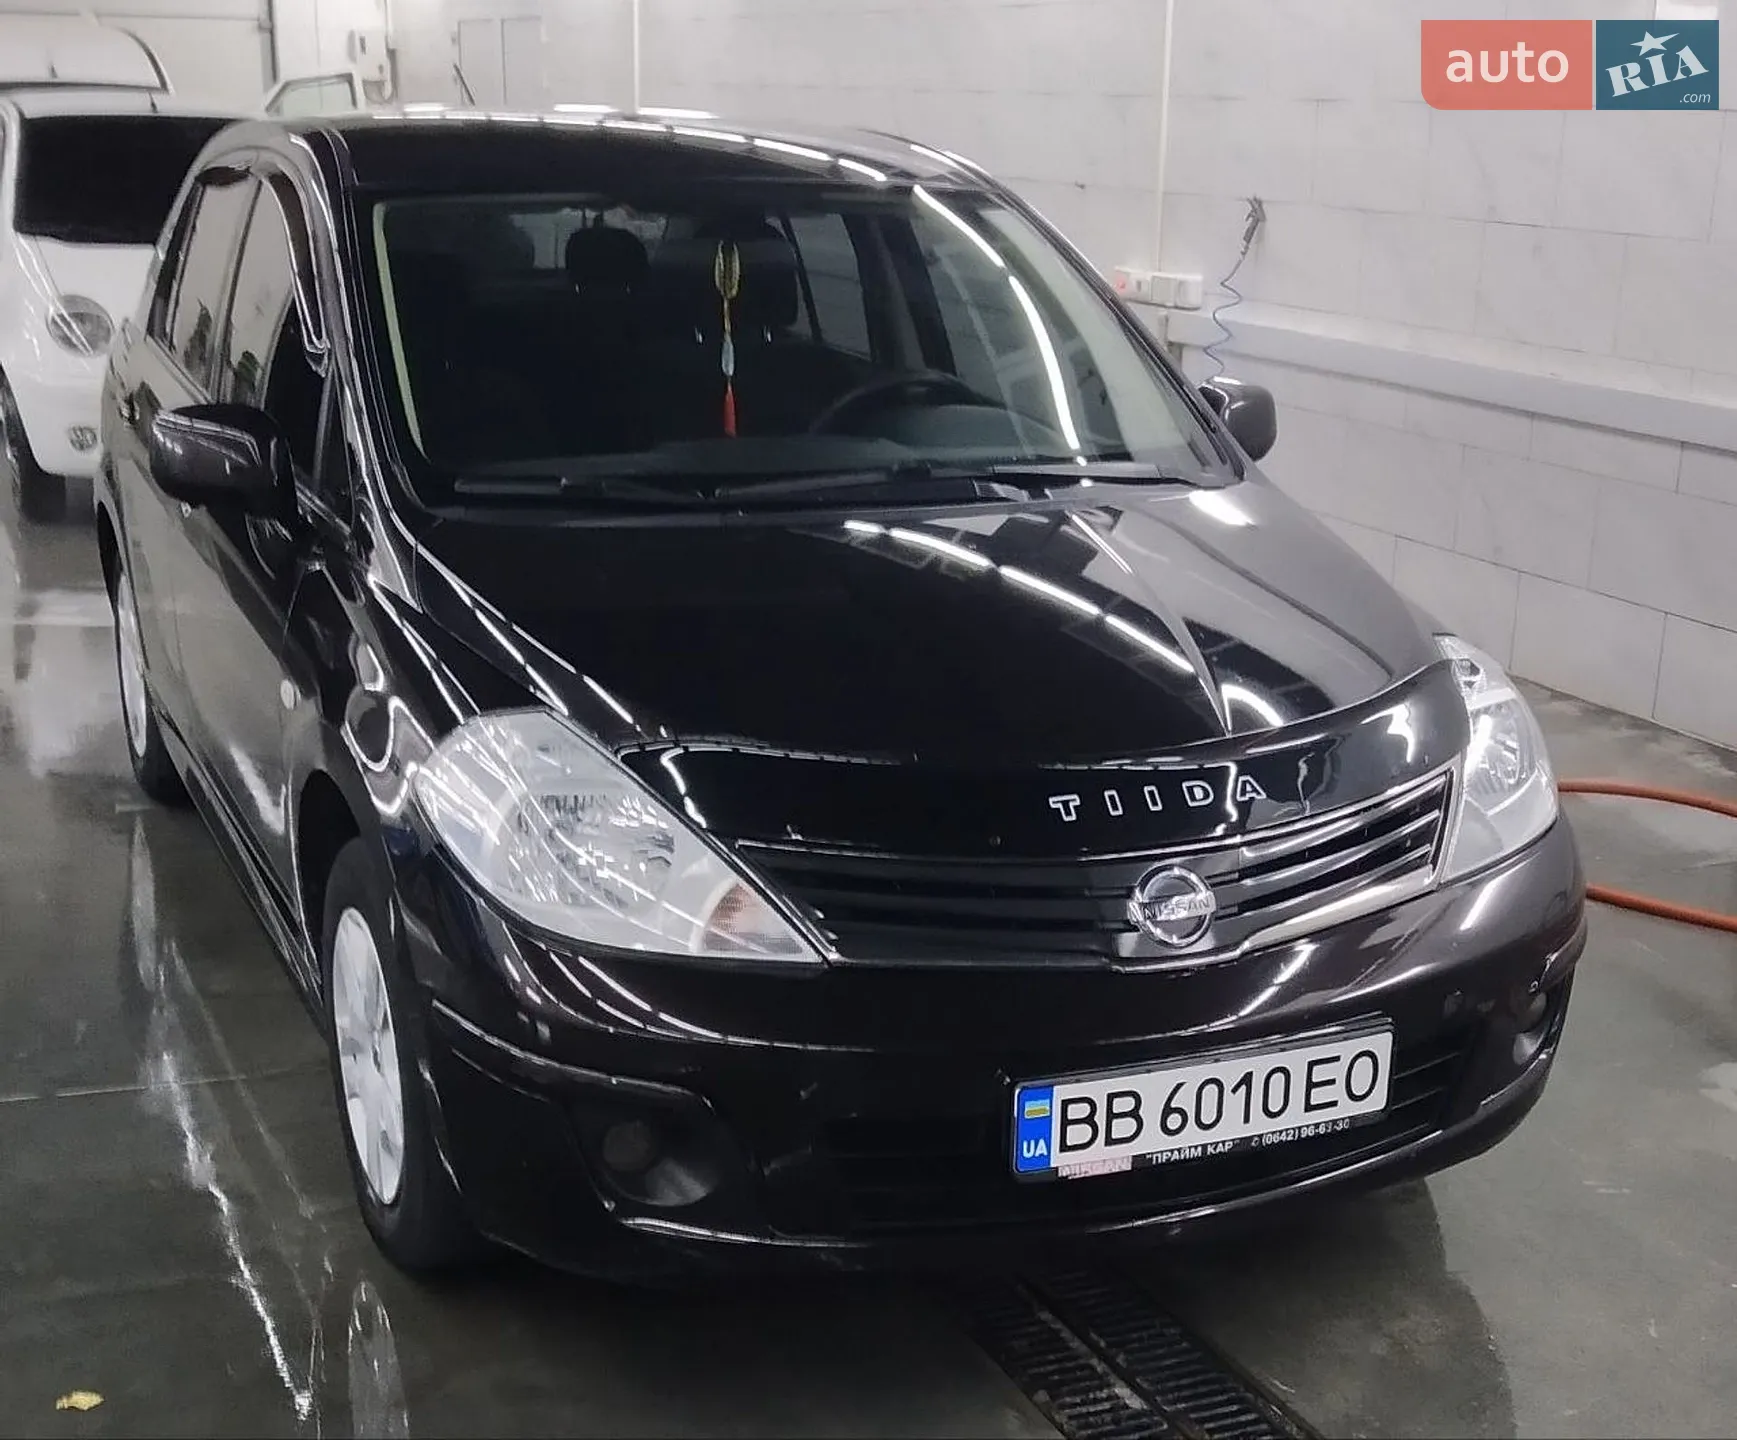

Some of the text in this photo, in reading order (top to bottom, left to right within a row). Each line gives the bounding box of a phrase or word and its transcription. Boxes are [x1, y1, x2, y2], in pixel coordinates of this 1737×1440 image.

[1049, 776, 1266, 822] TIIDA
[1142, 898, 1211, 919] NISSAN
[1058, 1049, 1380, 1154] BB 6010 EO
[1023, 1138, 1048, 1158] UA
